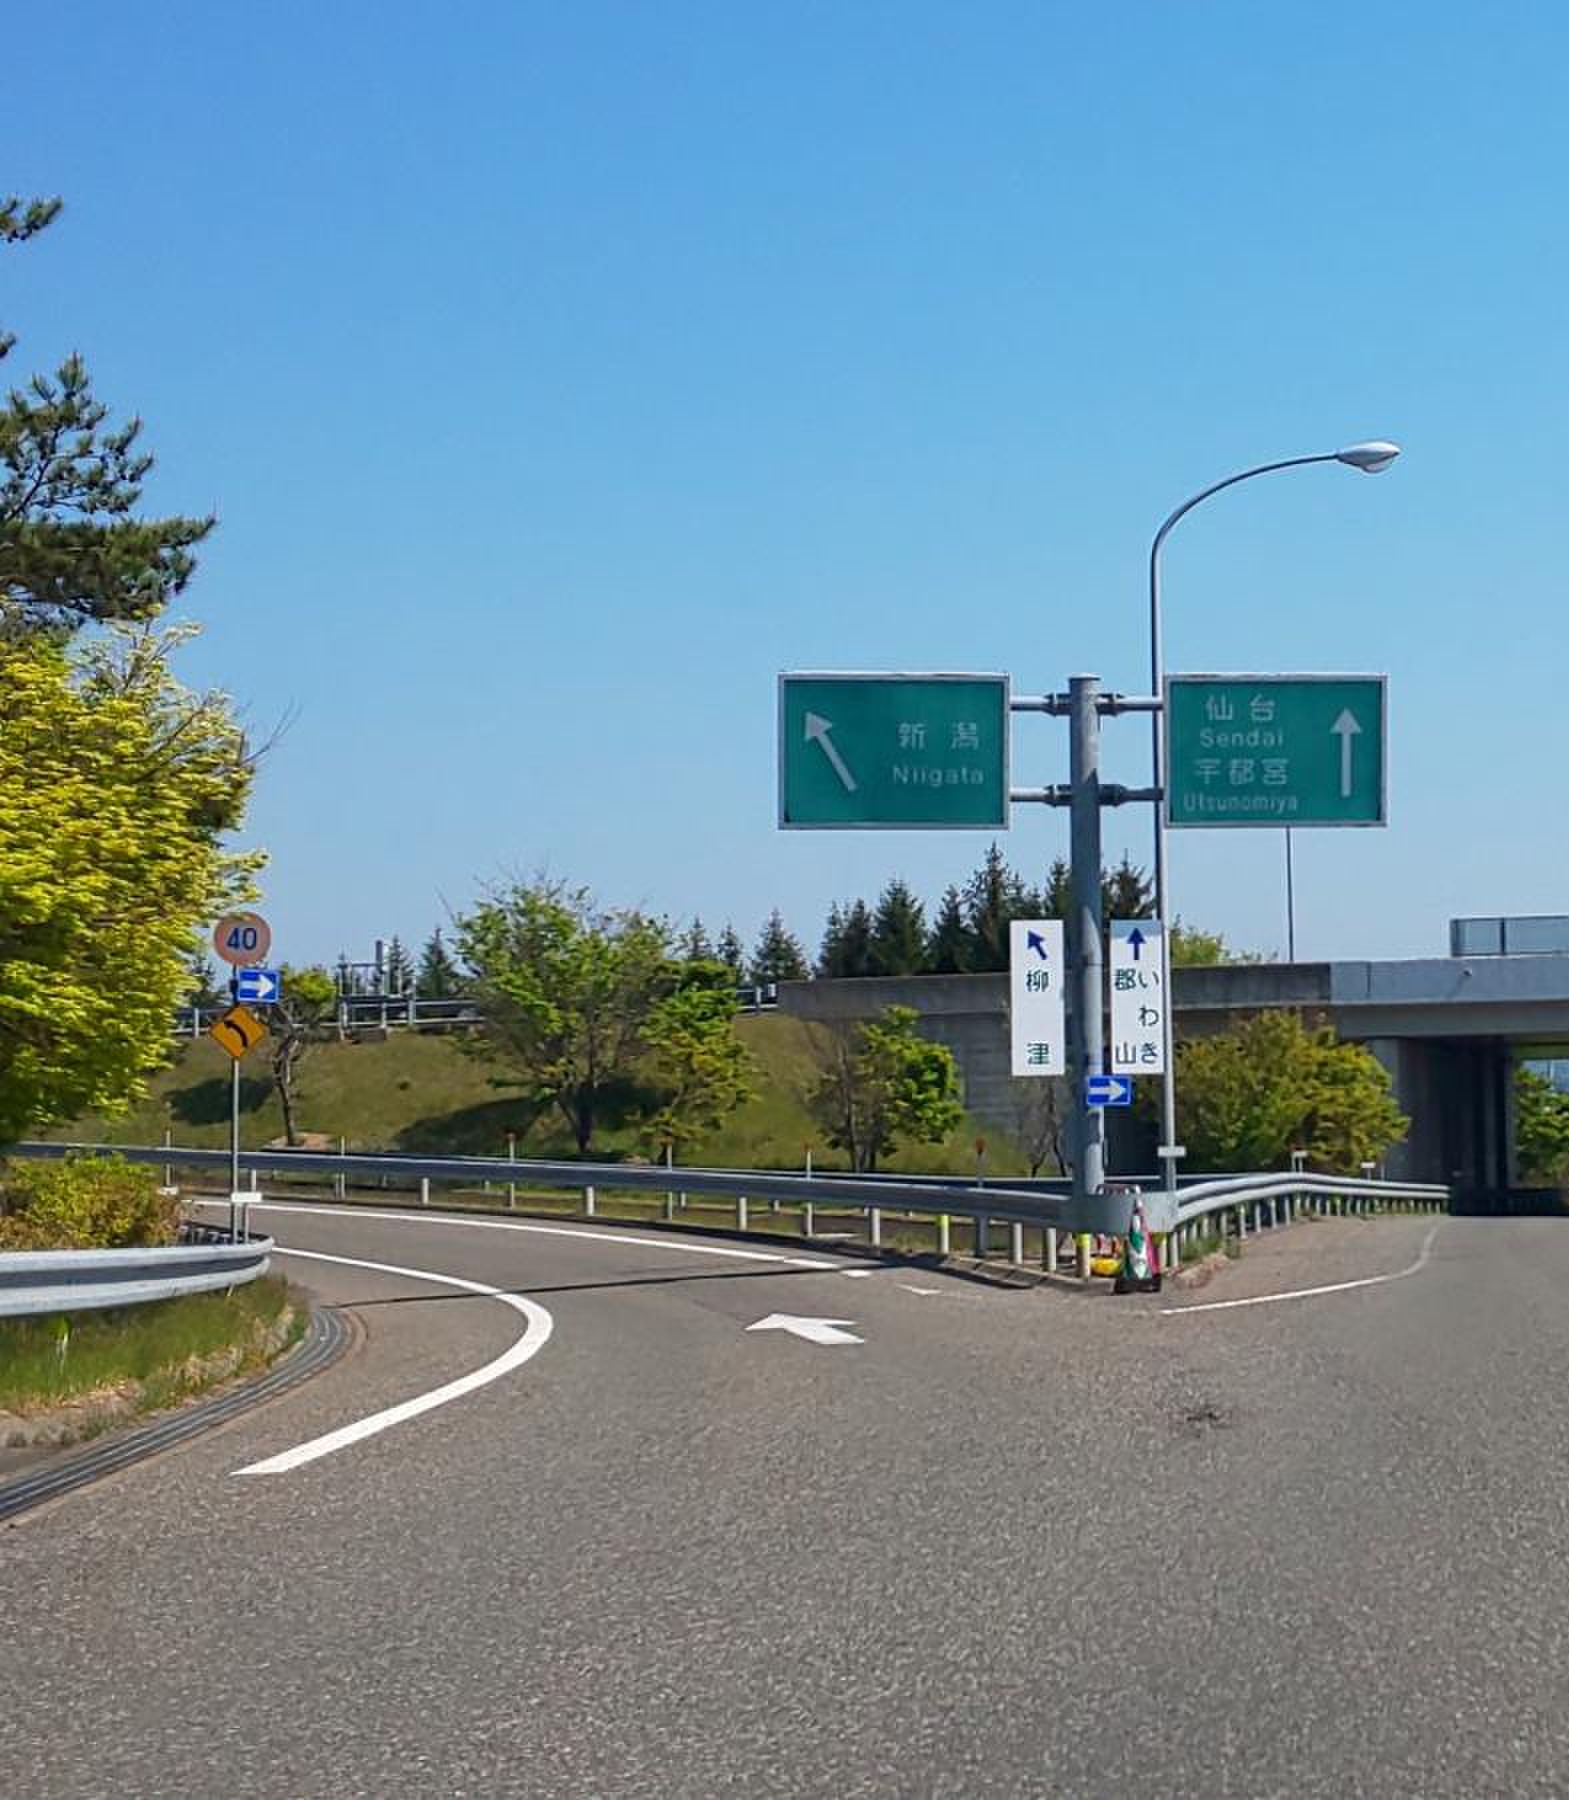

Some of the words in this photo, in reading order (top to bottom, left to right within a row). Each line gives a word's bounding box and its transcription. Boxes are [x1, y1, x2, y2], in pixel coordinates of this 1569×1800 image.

[1205, 693, 1276, 722] 仙台
[898, 721, 979, 751] 新潟
[1200, 727, 1284, 748] Sendai
[893, 765, 984, 788] Niigata
[1193, 757, 1289, 785] 宇都宮
[1183, 792, 1297, 814] Utsunomiya
[226, 927, 257, 950] 40
[1026, 969, 1050, 1065] 柳津
[1114, 967, 1137, 1065] 郡山
[1138, 970, 1160, 1064] いわき
